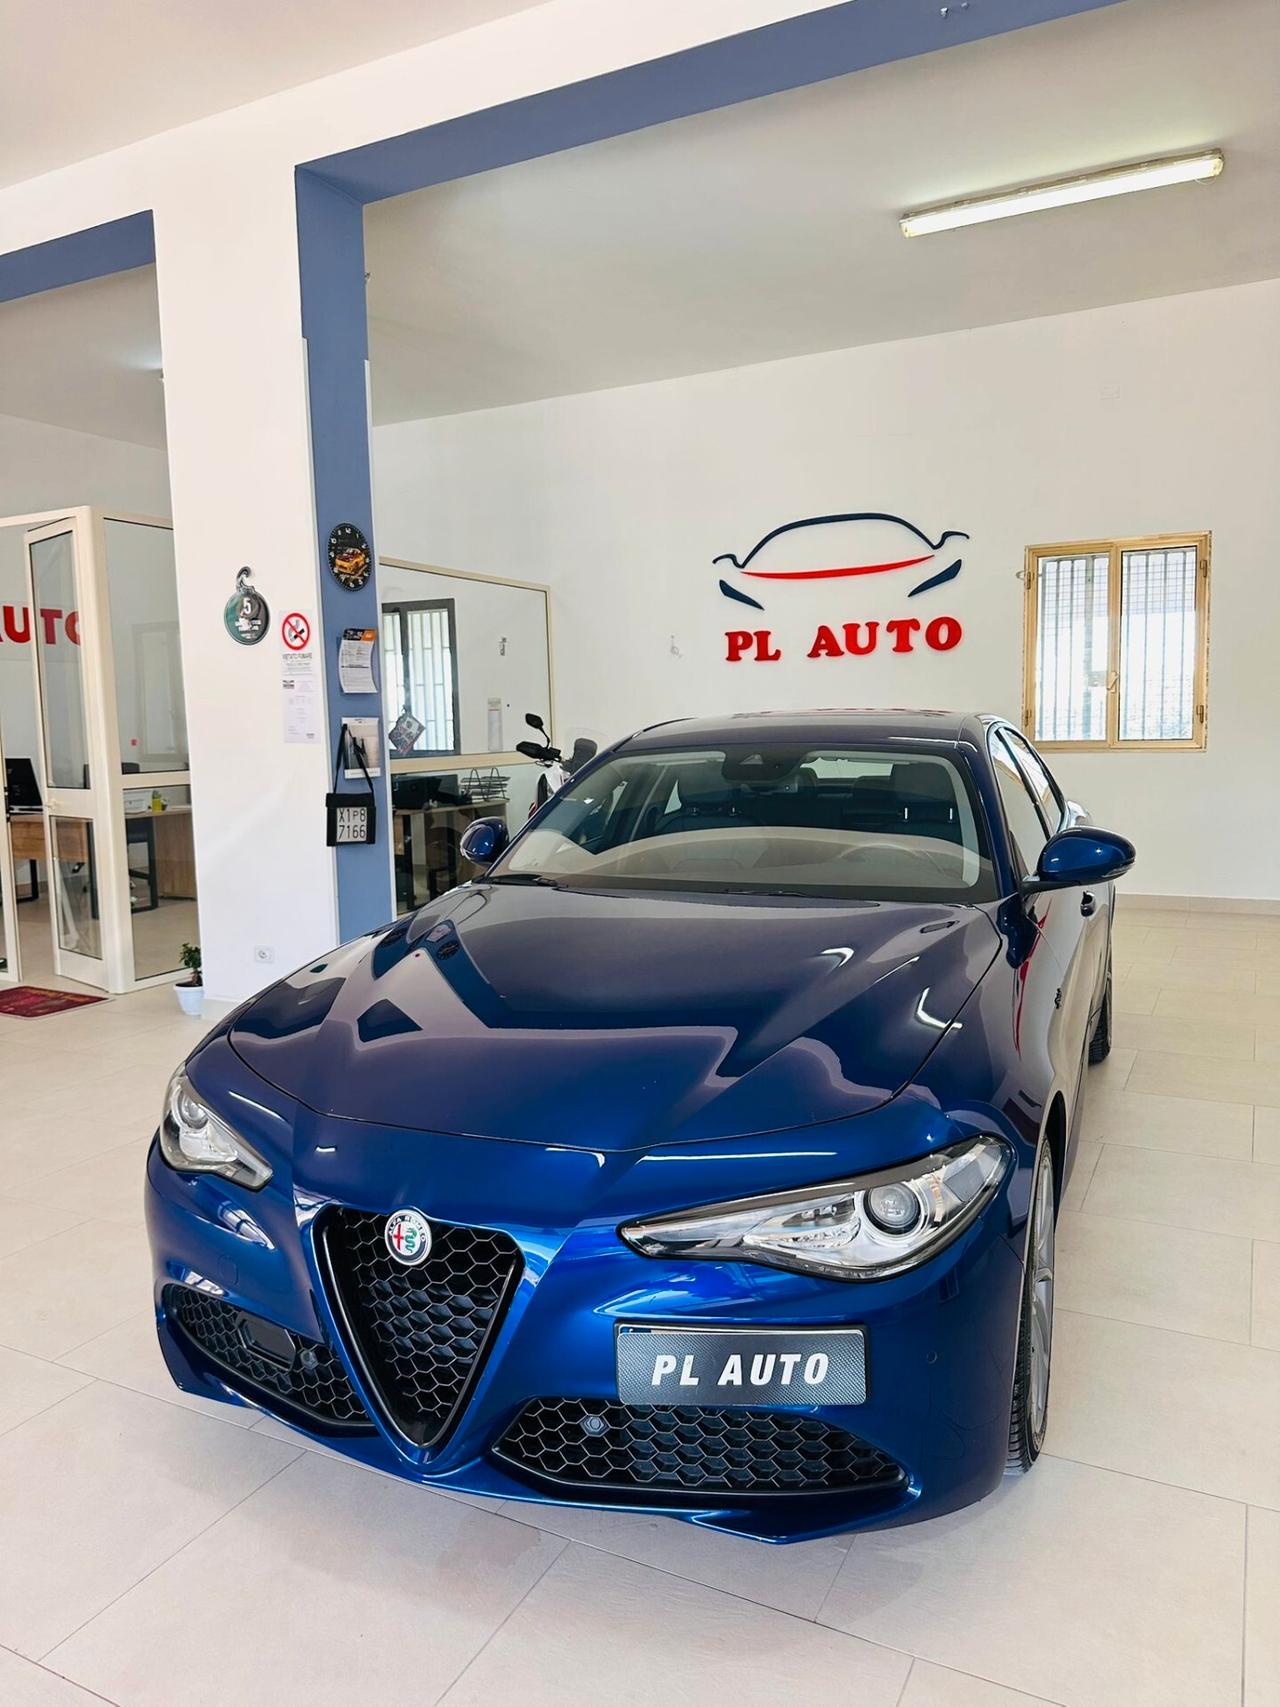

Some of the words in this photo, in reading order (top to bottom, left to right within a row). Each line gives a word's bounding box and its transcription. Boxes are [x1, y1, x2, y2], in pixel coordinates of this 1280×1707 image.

[243, 597, 251, 615] 5
[0, 605, 81, 646] UTO
[725, 630, 782, 662] PL
[807, 616, 963, 658] AUTO
[338, 824, 366, 840] 7166
[651, 1354, 700, 1386] PL
[717, 1352, 829, 1386] AUTO
